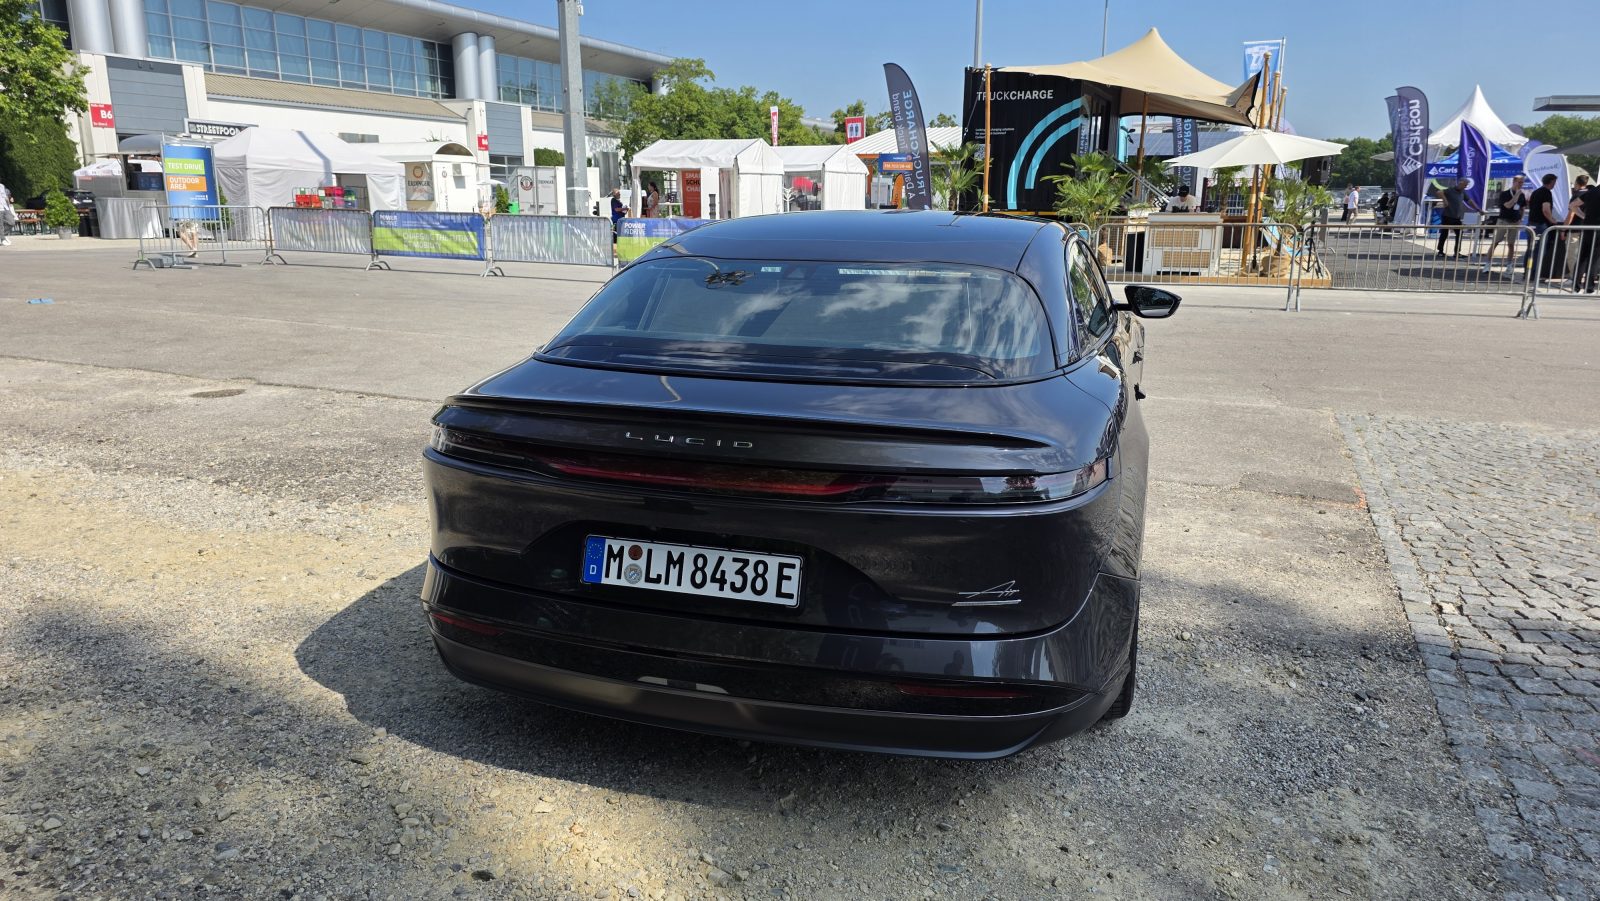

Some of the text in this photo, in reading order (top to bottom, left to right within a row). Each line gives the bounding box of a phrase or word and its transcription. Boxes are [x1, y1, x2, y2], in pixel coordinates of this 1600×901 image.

[100, 110, 113, 119] B6
[184, 163, 204, 171] DRIVE
[625, 431, 753, 448] LUCID
[604, 544, 625, 580] M
[589, 564, 597, 575] D
